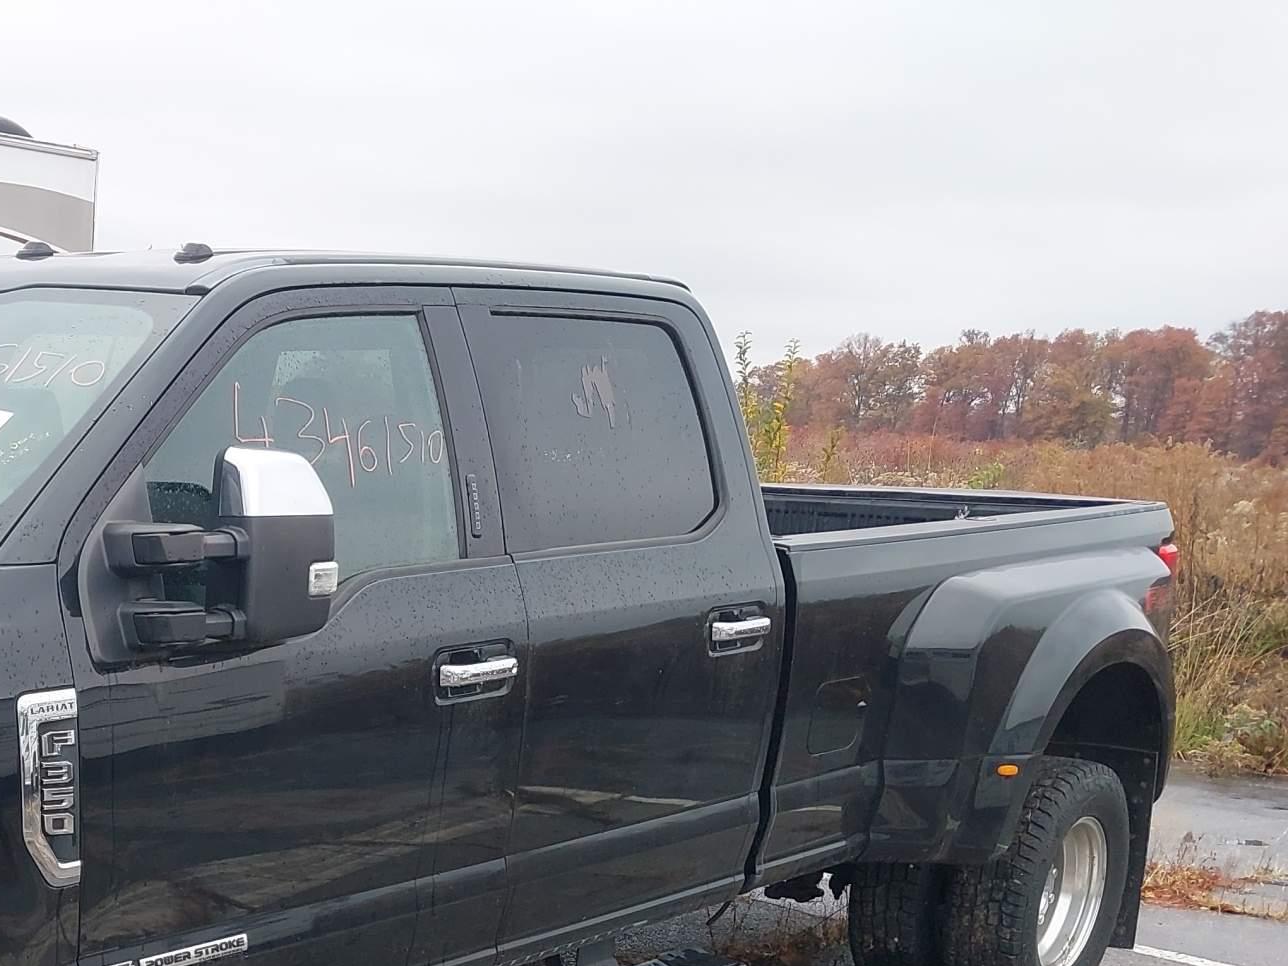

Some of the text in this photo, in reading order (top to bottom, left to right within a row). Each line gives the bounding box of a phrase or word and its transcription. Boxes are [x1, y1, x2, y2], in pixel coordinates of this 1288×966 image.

[234, 381, 444, 488] 43461510
[30, 701, 75, 715] LARIAT
[194, 936, 245, 959] STROKE
